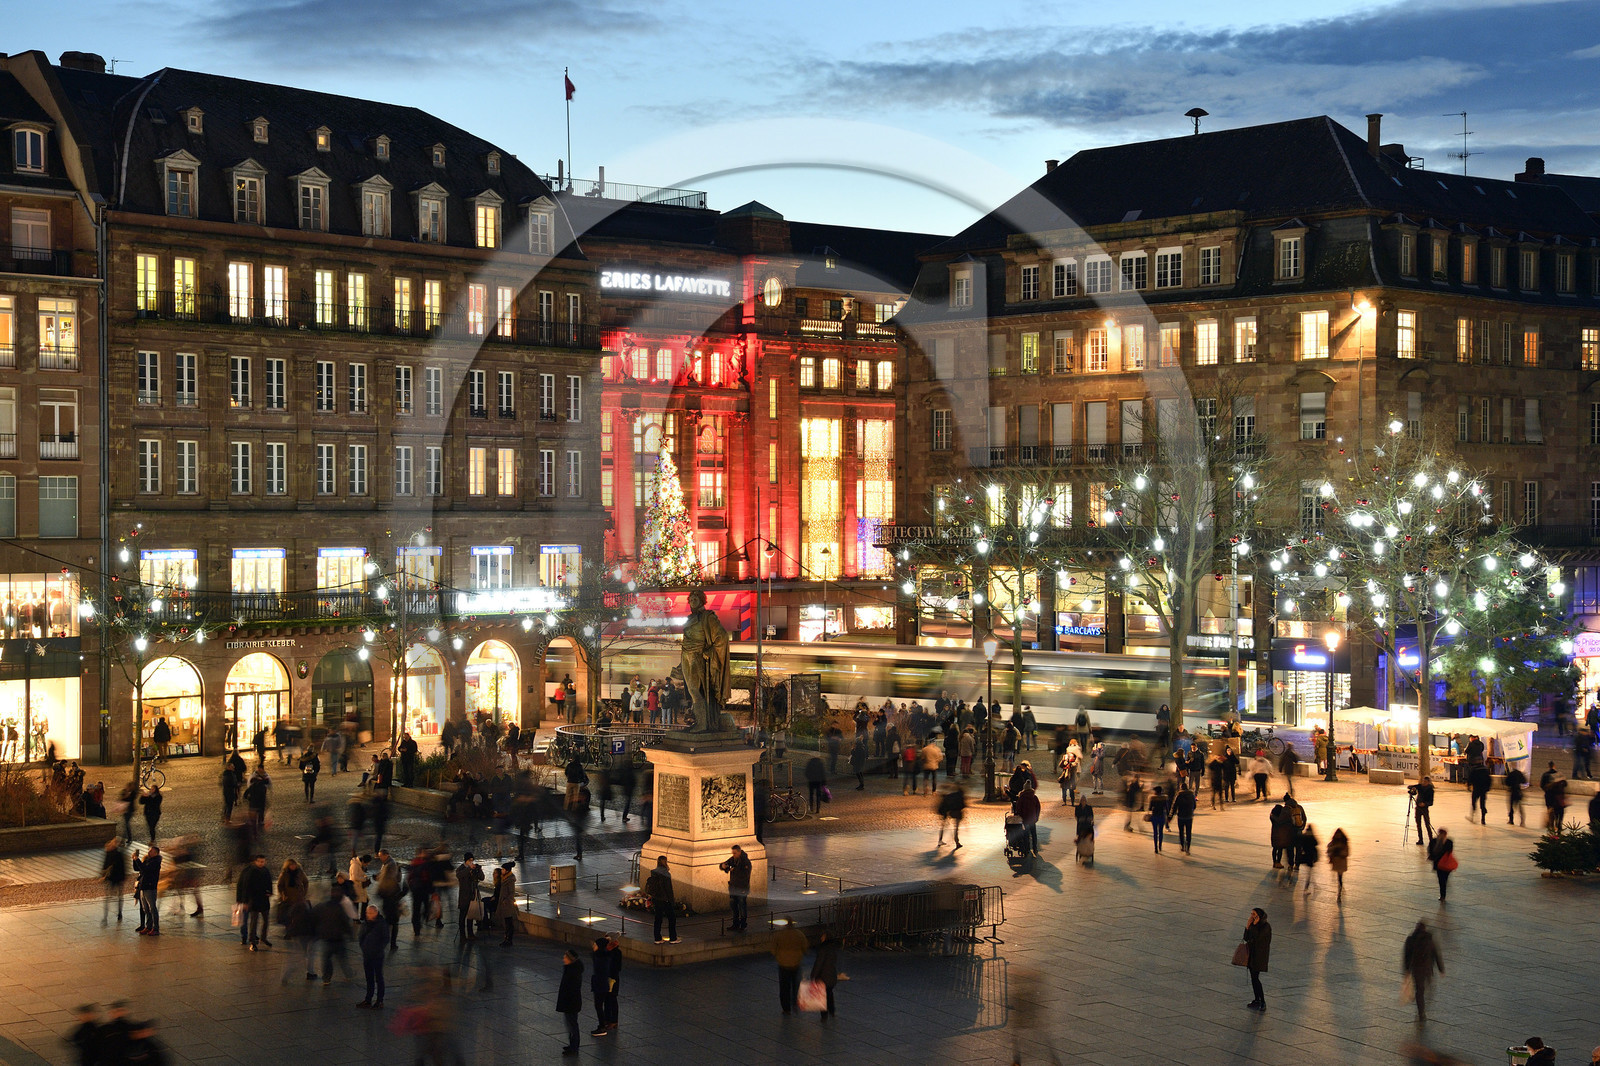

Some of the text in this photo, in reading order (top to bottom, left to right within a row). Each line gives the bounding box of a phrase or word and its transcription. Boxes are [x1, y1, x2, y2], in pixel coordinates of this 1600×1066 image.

[654, 275, 730, 297] LAFAYETTE
[1064, 626, 1101, 636] BARCLAYS
[226, 639, 296, 649] LIBRAIRIE KLEBER
[615, 741, 623, 752] P
